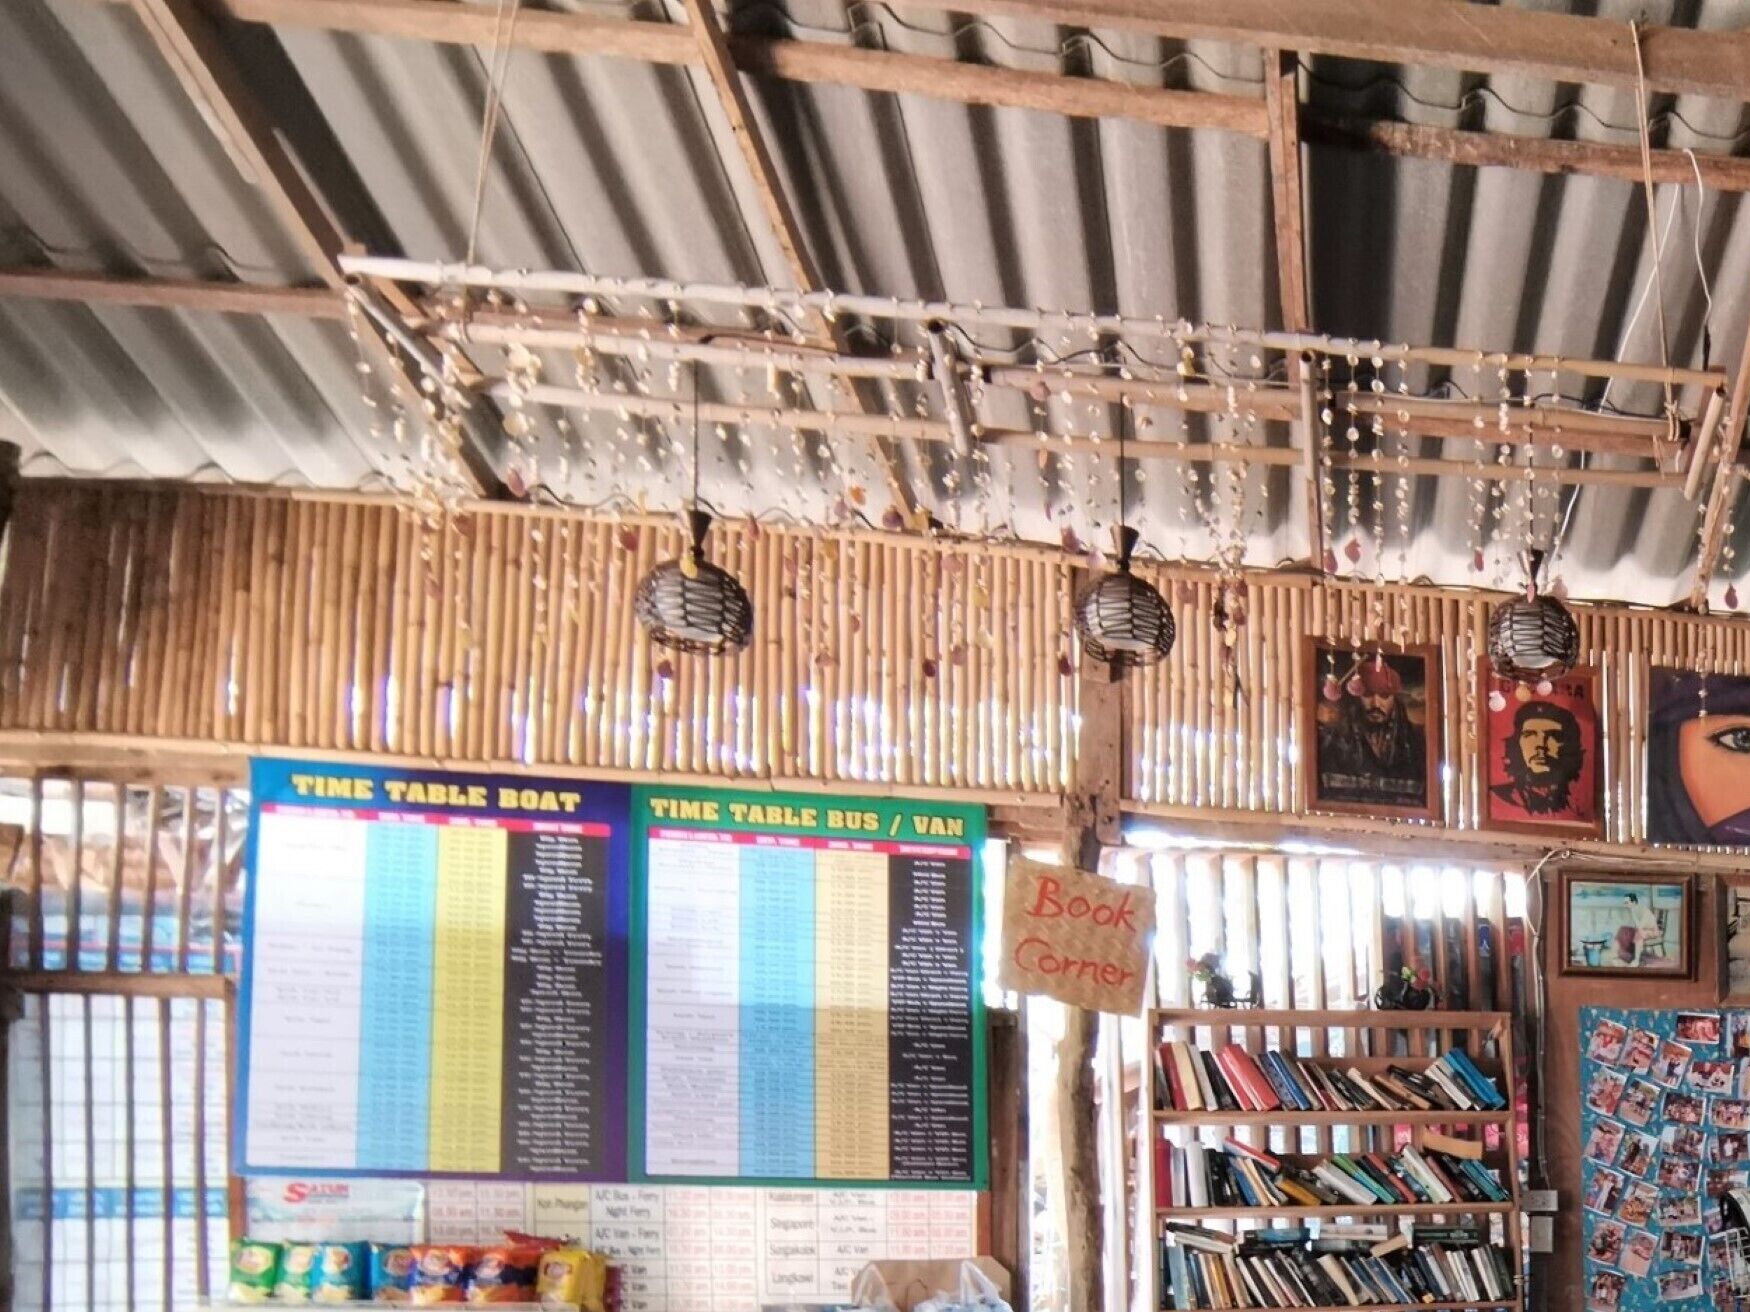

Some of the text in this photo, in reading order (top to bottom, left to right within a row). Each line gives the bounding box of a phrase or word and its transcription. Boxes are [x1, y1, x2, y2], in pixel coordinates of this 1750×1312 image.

[290, 774, 582, 813] TIME TABLE BOAT
[650, 798, 964, 837] TIME TABLE BUS / VAN
[1027, 872, 1136, 936] Book
[1014, 937, 1135, 986] Corner
